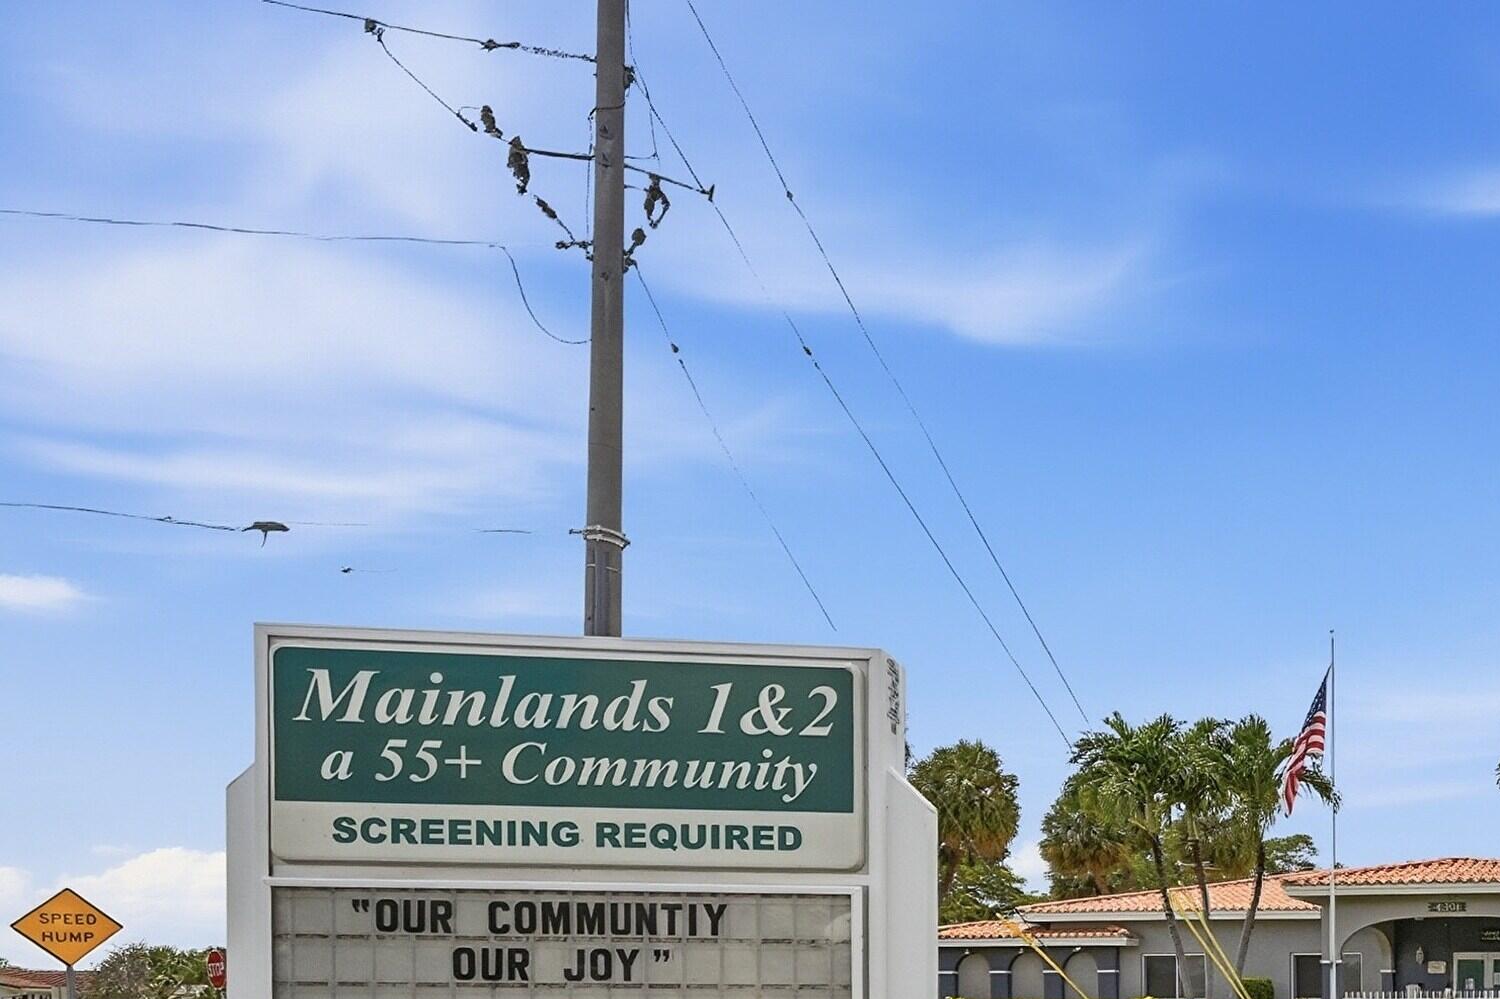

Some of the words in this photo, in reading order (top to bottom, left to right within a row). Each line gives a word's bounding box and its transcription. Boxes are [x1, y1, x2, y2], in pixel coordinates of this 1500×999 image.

[292, 667, 674, 733] Mainlands
[697, 682, 838, 737] 1&2
[320, 749, 354, 780] a
[374, 738, 482, 782] 55+
[501, 741, 818, 803] Community
[332, 816, 580, 847] SCREENING
[596, 822, 802, 851] REQUIRED
[39, 913, 97, 925] SPEED
[351, 898, 453, 934] "OUR
[488, 900, 727, 937] COMMUNTIY
[42, 931, 94, 943] HUMP
[207, 962, 224, 978] STOP
[452, 946, 529, 982] OUR
